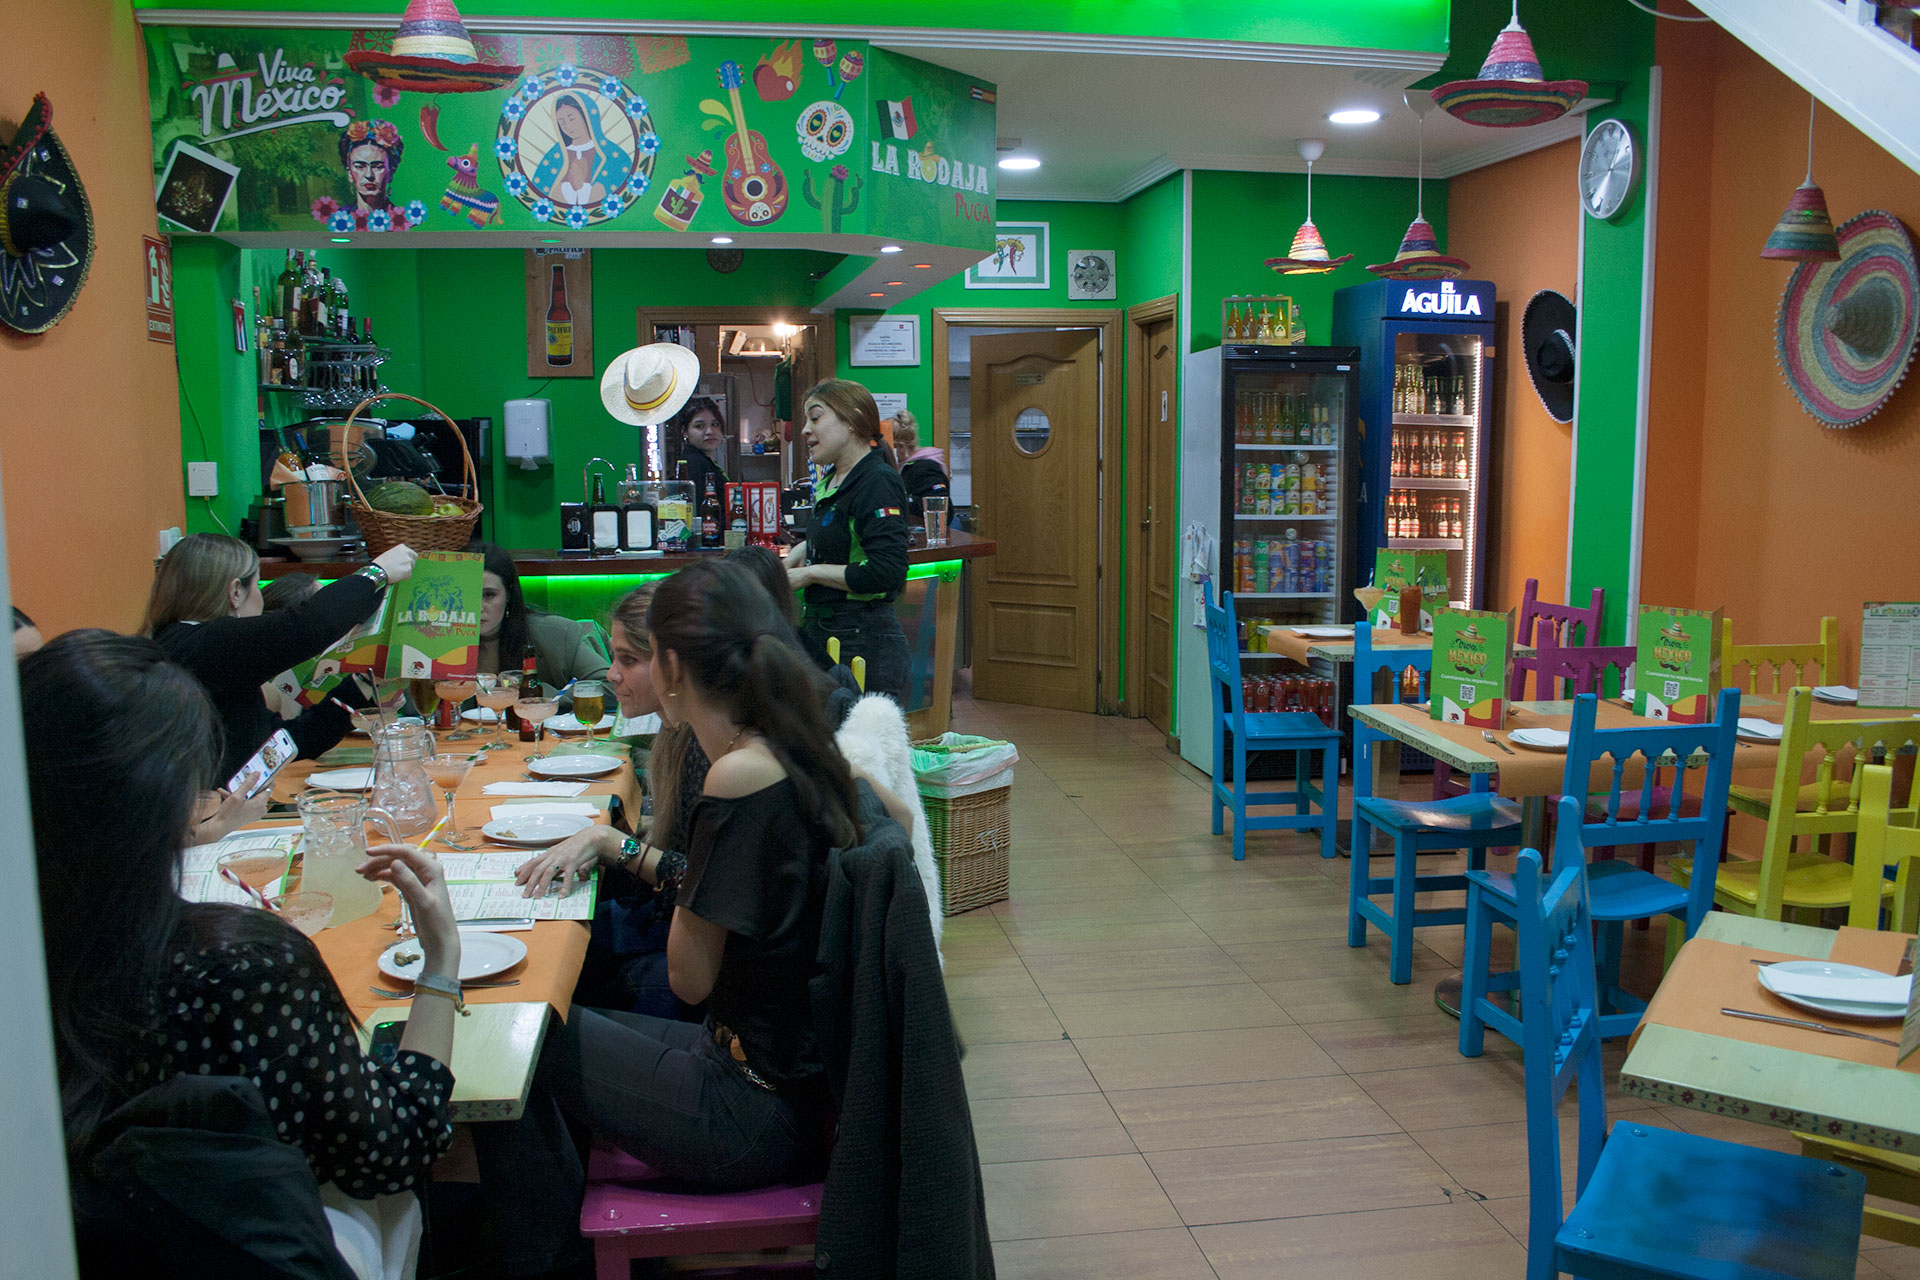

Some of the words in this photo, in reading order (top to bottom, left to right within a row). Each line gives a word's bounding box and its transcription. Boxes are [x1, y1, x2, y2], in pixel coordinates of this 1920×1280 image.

[257, 48, 316, 88] Viva
[191, 77, 346, 137] México
[871, 140, 900, 177] LA
[907, 148, 989, 194] RODAJA
[954, 191, 991, 224] PUGA
[1440, 281, 1457, 294] EL
[1400, 288, 1482, 316] ÁGUILA
[149, 319, 172, 334] EXTINTOR
[397, 611, 414, 623] LA
[418, 610, 476, 624] RODAJA
[1447, 649, 1487, 667] MEXICO
[1653, 647, 1692, 663] MEXICO
